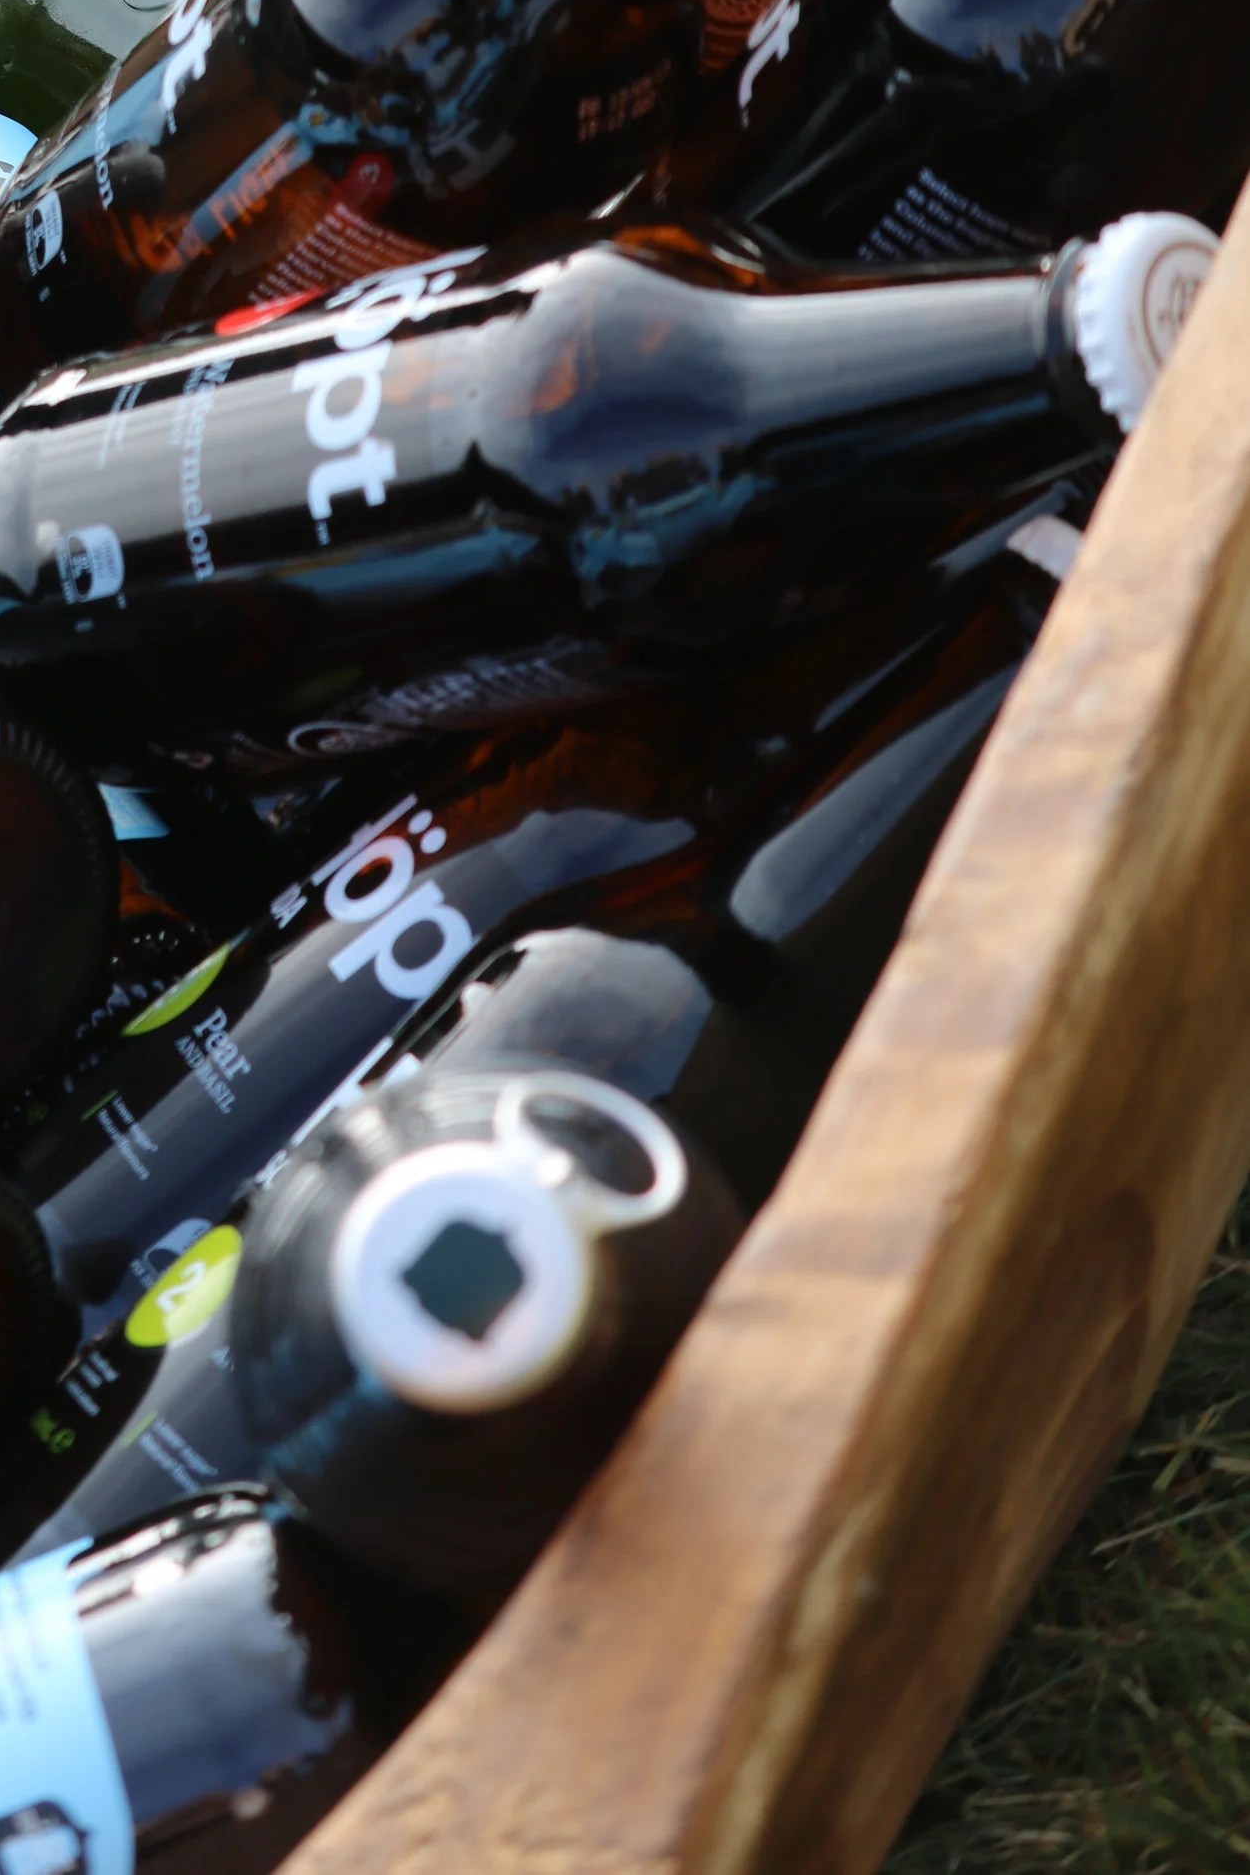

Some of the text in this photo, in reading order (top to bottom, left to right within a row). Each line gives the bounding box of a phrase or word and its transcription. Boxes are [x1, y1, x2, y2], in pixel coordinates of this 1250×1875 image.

[180, 357, 238, 583] Watermelon
[193, 991, 251, 1081] Pear
[155, 1259, 207, 1313] 2
